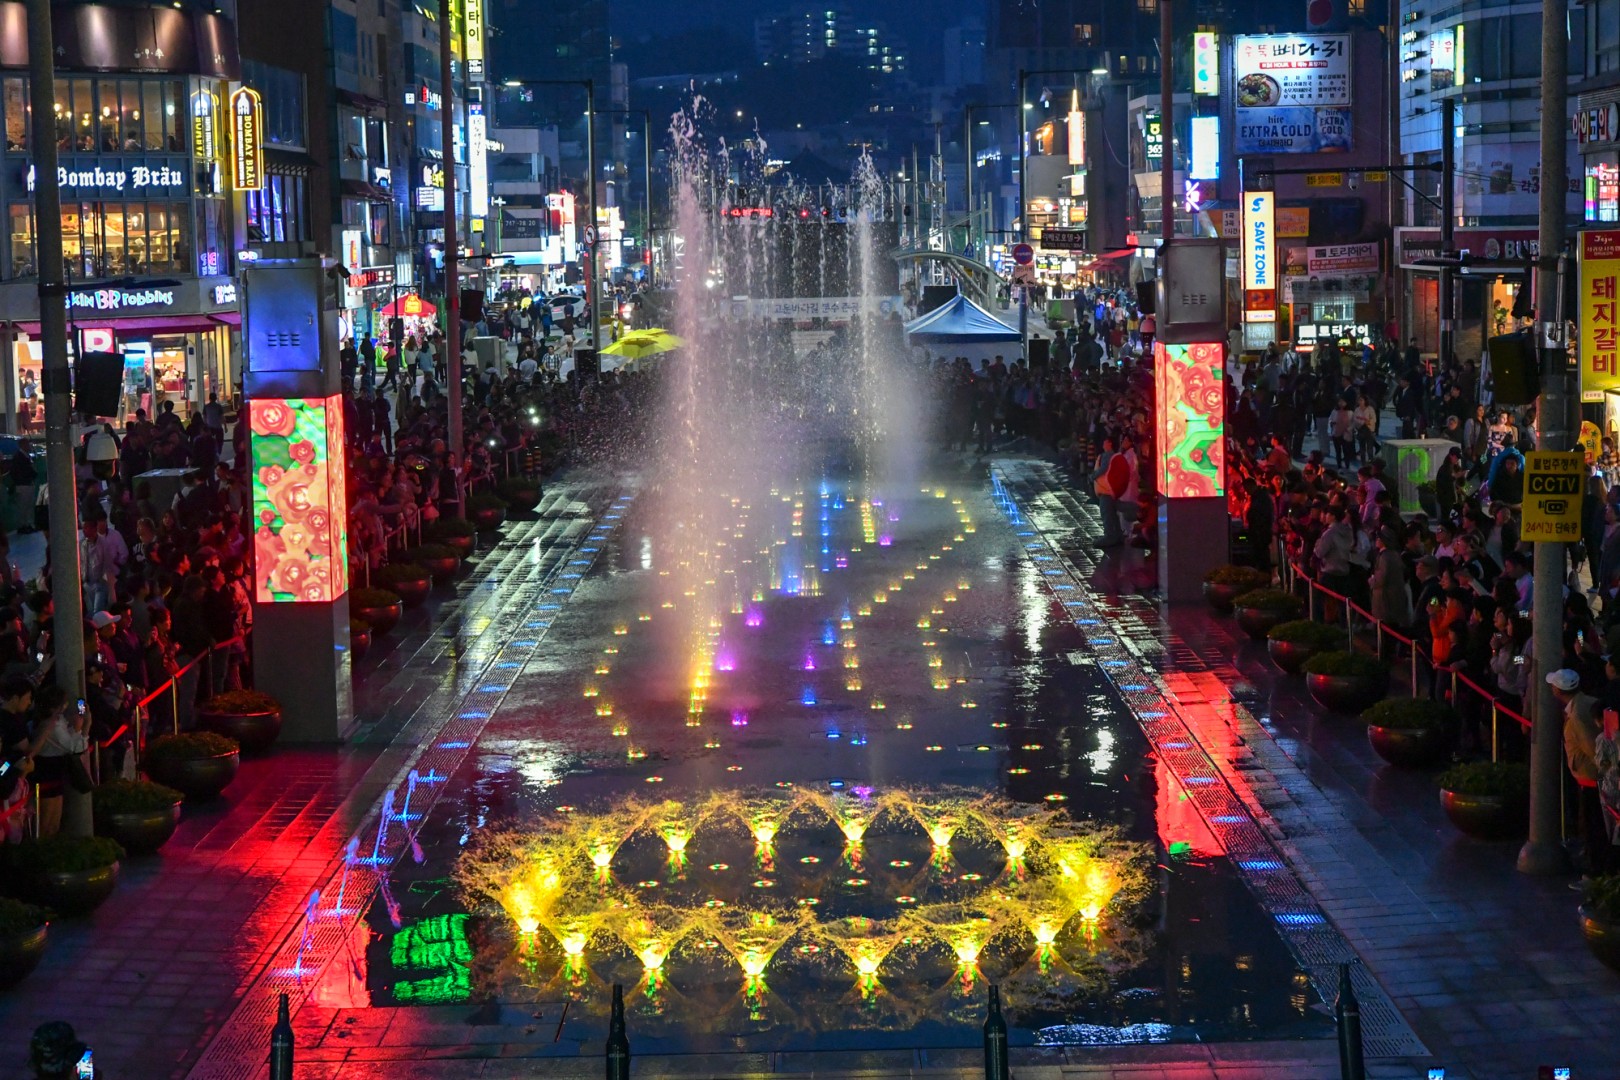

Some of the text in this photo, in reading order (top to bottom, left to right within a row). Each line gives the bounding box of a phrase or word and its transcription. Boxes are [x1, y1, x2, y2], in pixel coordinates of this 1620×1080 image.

[1319, 116, 1344, 126] EXTRA
[1572, 106, 1608, 144] 아이코인
[244, 115, 253, 157] BOMBAY
[1241, 124, 1311, 138] EXTRA COLD
[1321, 126, 1342, 135] COLD
[1147, 144, 1163, 154] 365
[58, 166, 183, 190] Bombay Bräu
[1254, 221, 1265, 285] SAVE ZONE
[95, 289, 121, 309] BR
[122, 291, 173, 308] robbins
[1591, 276, 1620, 377] 돼지갈비
[1534, 458, 1578, 471] 불법주정차
[1532, 476, 1576, 493] CCTV
[1526, 522, 1578, 534] 24시간 단속중
